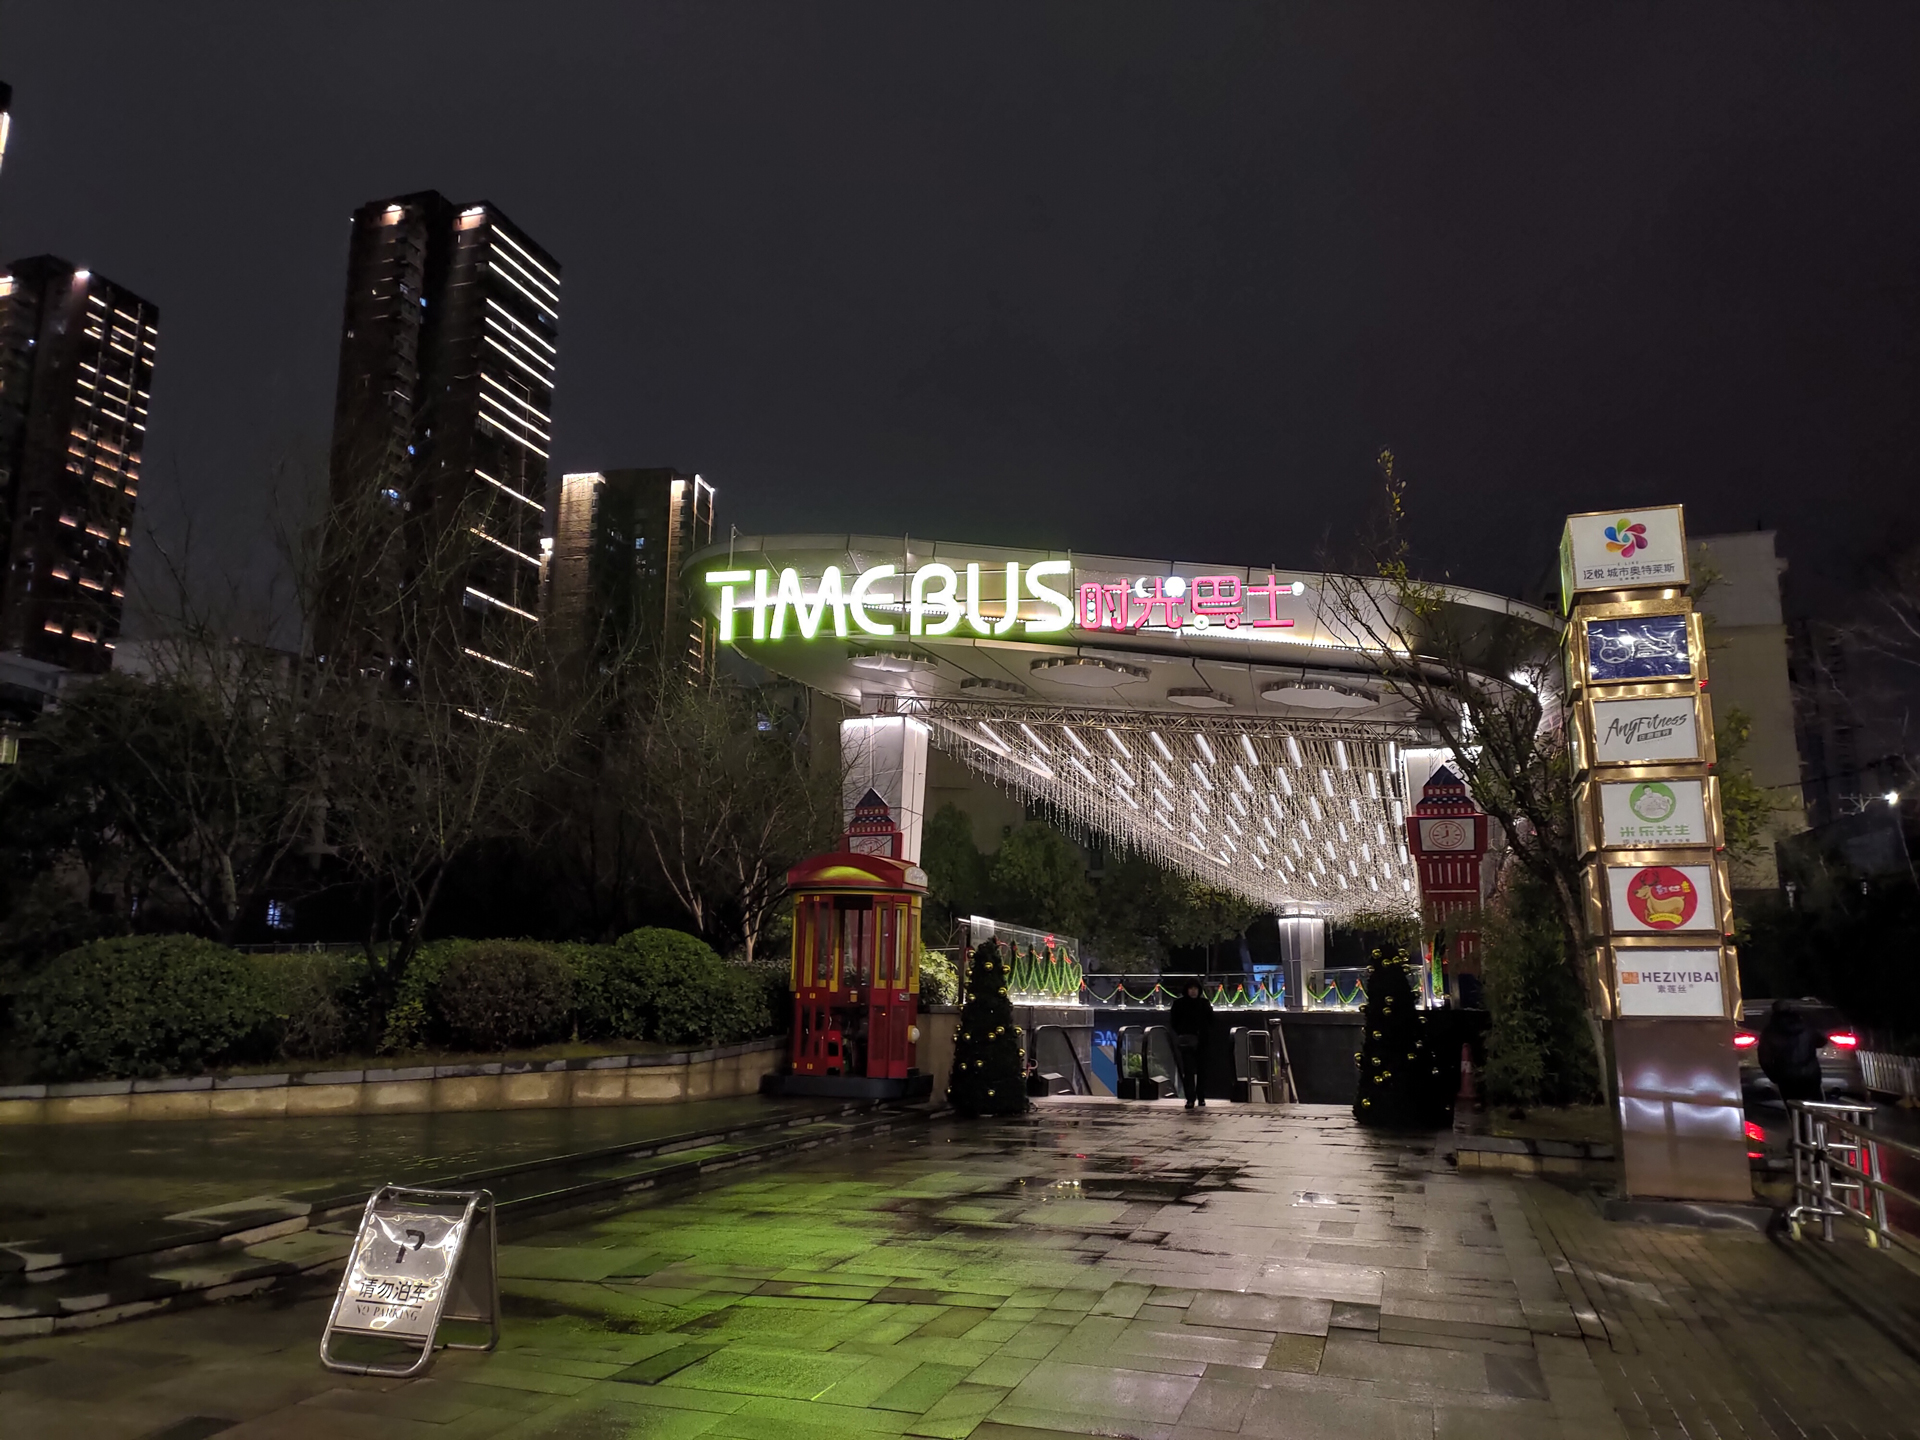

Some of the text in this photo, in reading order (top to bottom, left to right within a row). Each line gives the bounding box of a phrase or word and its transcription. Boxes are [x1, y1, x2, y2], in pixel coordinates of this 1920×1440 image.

[1583, 568, 1605, 580] 泛悦
[1607, 562, 1675, 577] 城市奥特莱斯
[705, 560, 1073, 641] TIMEBUS
[1080, 574, 1304, 631] 时光巴士
[1604, 713, 1688, 745] AnyFitness
[1619, 824, 1691, 837] 米乐先生
[1642, 971, 1719, 982] HEZIYIBAI
[358, 1277, 430, 1303] 请勿泊车
[355, 1304, 418, 1322] NO PARKING
